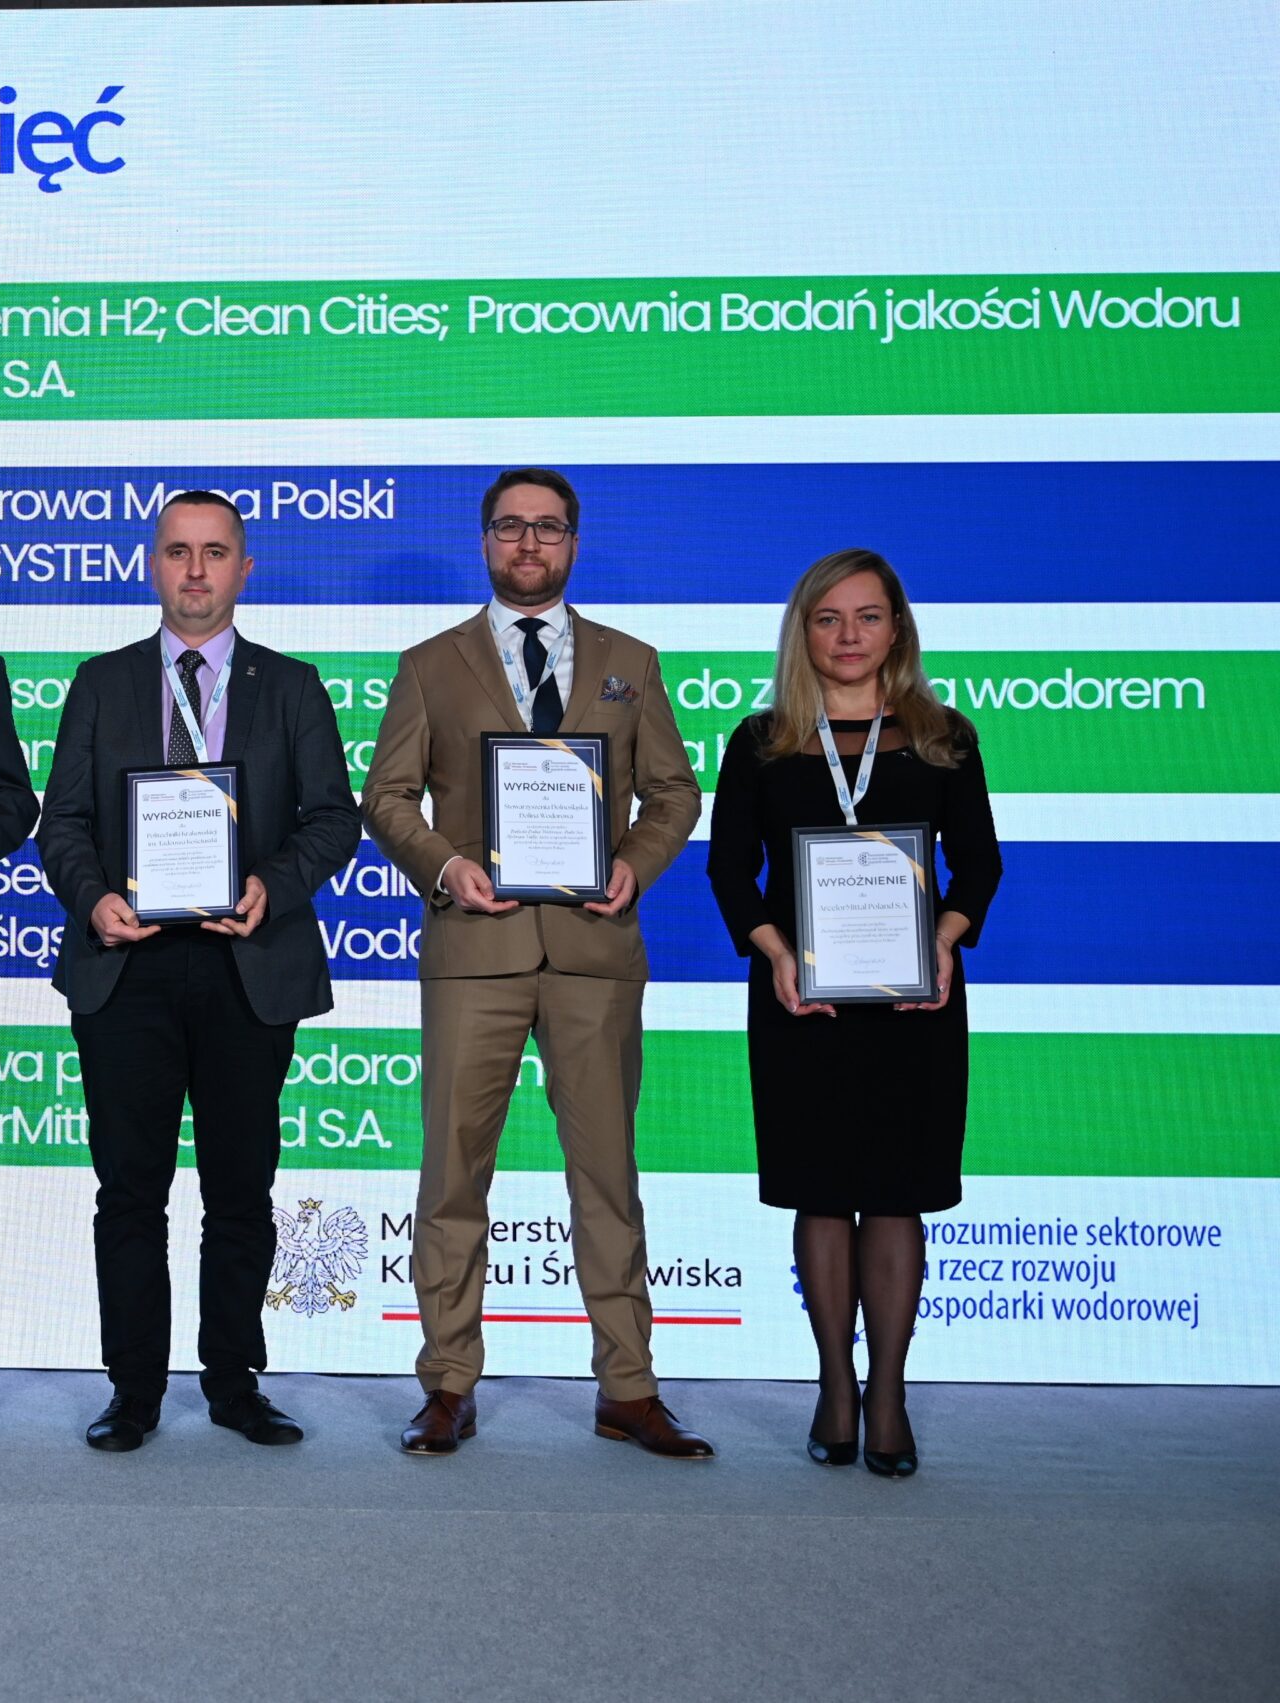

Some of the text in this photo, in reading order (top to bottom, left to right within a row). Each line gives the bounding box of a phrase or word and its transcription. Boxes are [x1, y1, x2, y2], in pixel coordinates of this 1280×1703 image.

[101, 298, 167, 343] H2;
[175, 296, 311, 336] Clean
[319, 294, 449, 341] Cities;
[468, 290, 711, 334] Pracownia
[721, 288, 877, 332] Badań
[880, 287, 1041, 344] jakości
[1049, 287, 1240, 329] Wodoru
[3, 360, 75, 399] S.A.
[271, 477, 396, 521] Polski
[965, 667, 1205, 710] wodorem
[504, 780, 586, 792] WYRÓŻNIENIE
[142, 808, 222, 821] WYRÓŻNIENIE
[816, 874, 907, 888] WYRÓŻNIENIE
[318, 1108, 393, 1148] S.A.
[923, 1216, 1222, 1247] rozumienie sektorowe
[524, 1256, 531, 1285] i
[939, 1259, 1004, 1282] rzecz
[1012, 1254, 1116, 1290] rozwoju
[917, 1289, 1199, 1330] ospodarki wodorowej
